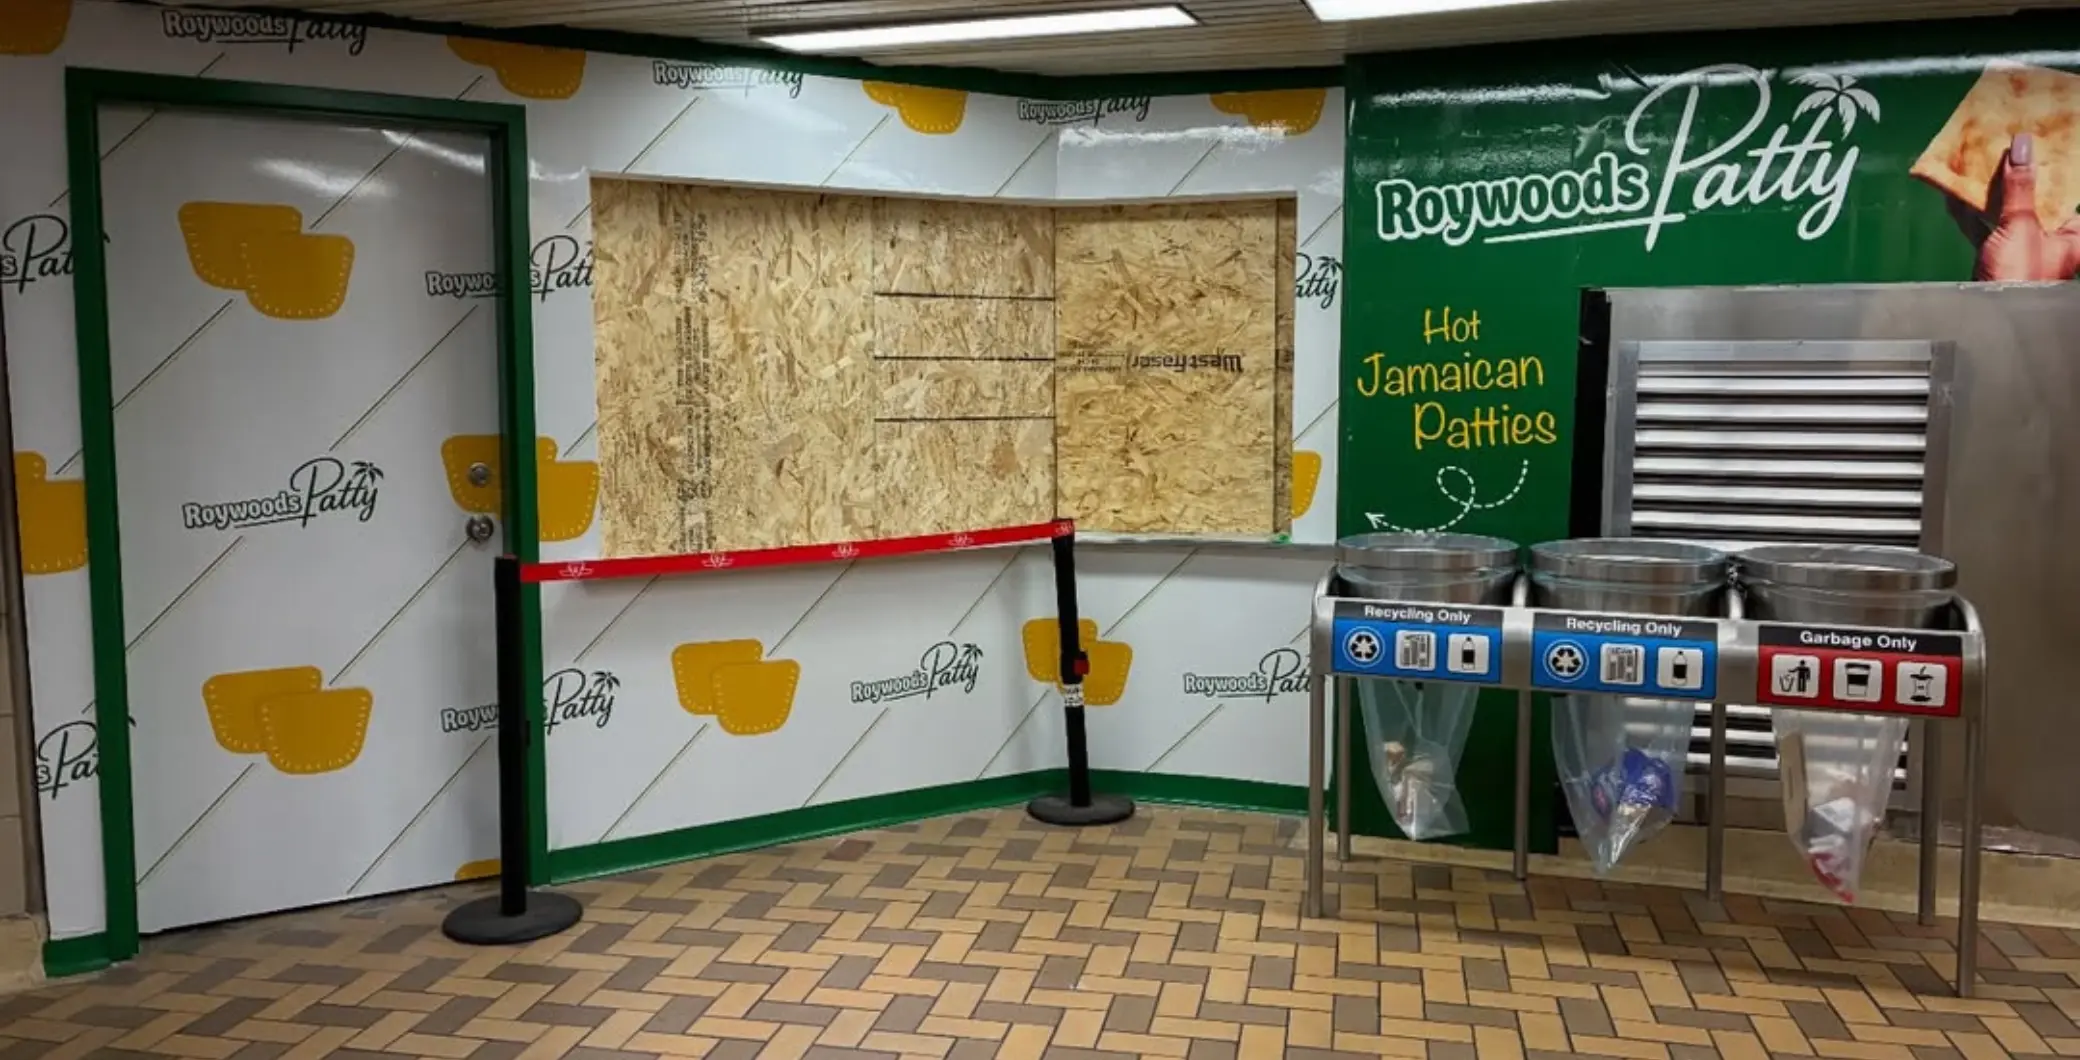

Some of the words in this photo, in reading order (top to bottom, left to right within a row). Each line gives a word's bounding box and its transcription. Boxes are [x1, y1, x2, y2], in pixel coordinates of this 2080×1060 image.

[1376, 152, 1650, 246] Roywoods
[1625, 63, 1860, 252] Patty
[3, 215, 75, 294] Pat
[1423, 306, 1481, 345] Hot
[1357, 351, 1544, 397] Jamaican
[1414, 401, 1557, 450] Patties
[182, 491, 302, 530] Roywoods
[290, 457, 379, 528] Patty
[1364, 605, 1434, 623] Recycling
[1438, 609, 1472, 625] Only
[1566, 617, 1642, 635] Recycling
[1646, 621, 1682, 637] Only
[1800, 630, 1872, 650] Garbage
[1877, 634, 1917, 652] Only
[850, 670, 928, 703] Roywoods
[920, 641, 979, 700] Patty
[1183, 672, 1268, 697] Roywoods
[543, 668, 615, 736] Patty
